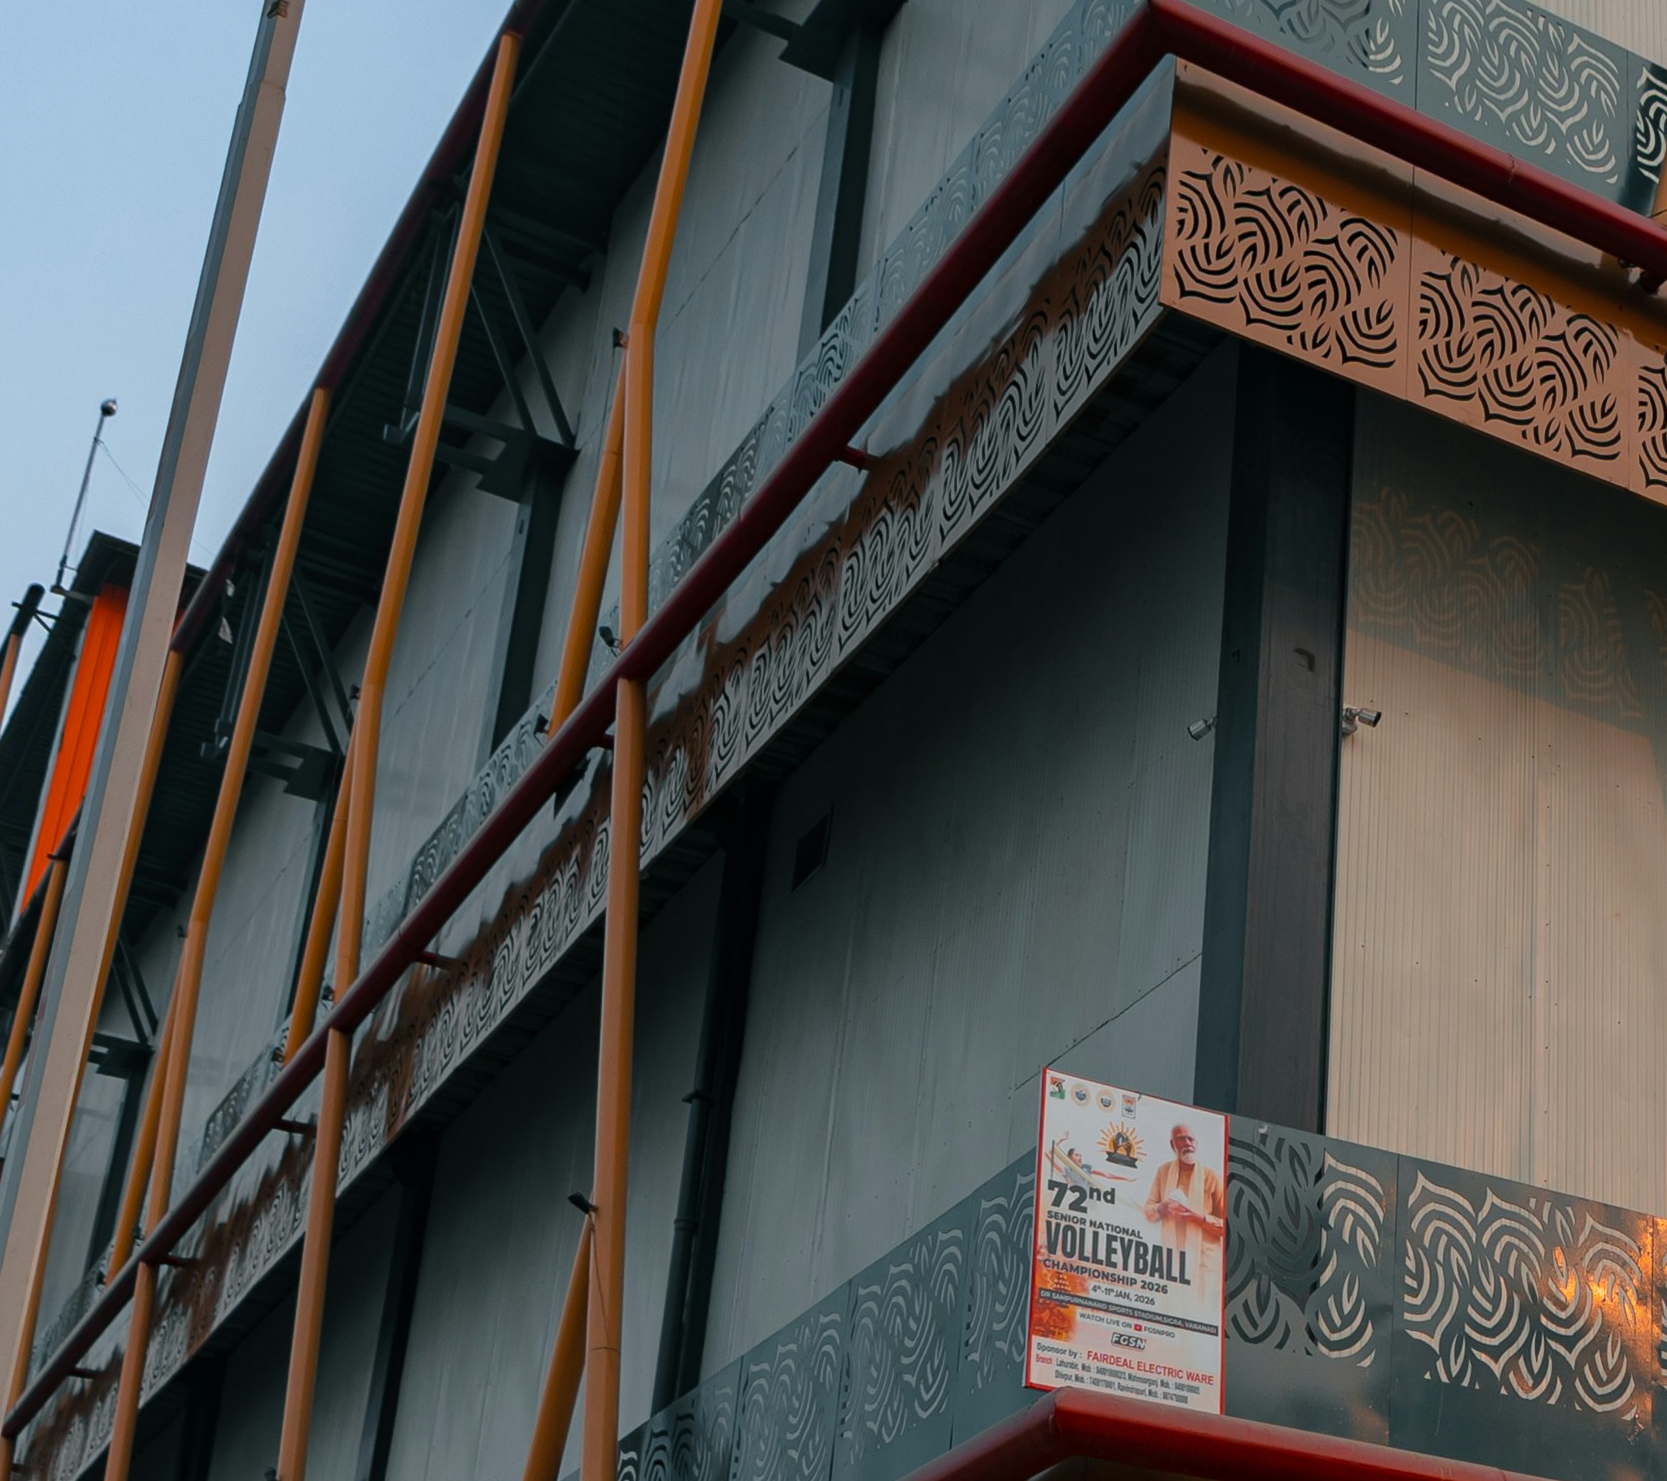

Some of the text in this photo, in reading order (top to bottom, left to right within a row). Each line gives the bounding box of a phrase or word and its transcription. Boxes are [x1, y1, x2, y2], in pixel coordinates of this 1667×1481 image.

[1047, 1179, 1116, 1214] 72nd
[1046, 1210, 1144, 1240] SENIOR NATIONAL
[1045, 1220, 1191, 1286] VOLLEYBALL
[1043, 1258, 1169, 1295] CHAMPIONSHIP 2026
[1134, 1293, 1156, 1306] 2026
[1078, 1311, 1105, 1324] WATCH
[1105, 1317, 1120, 1328] LIVE
[1086, 1350, 1135, 1370] FAIRDEAL
[1136, 1361, 1183, 1380] ELECTRIC
[1185, 1370, 1214, 1386] WARE
